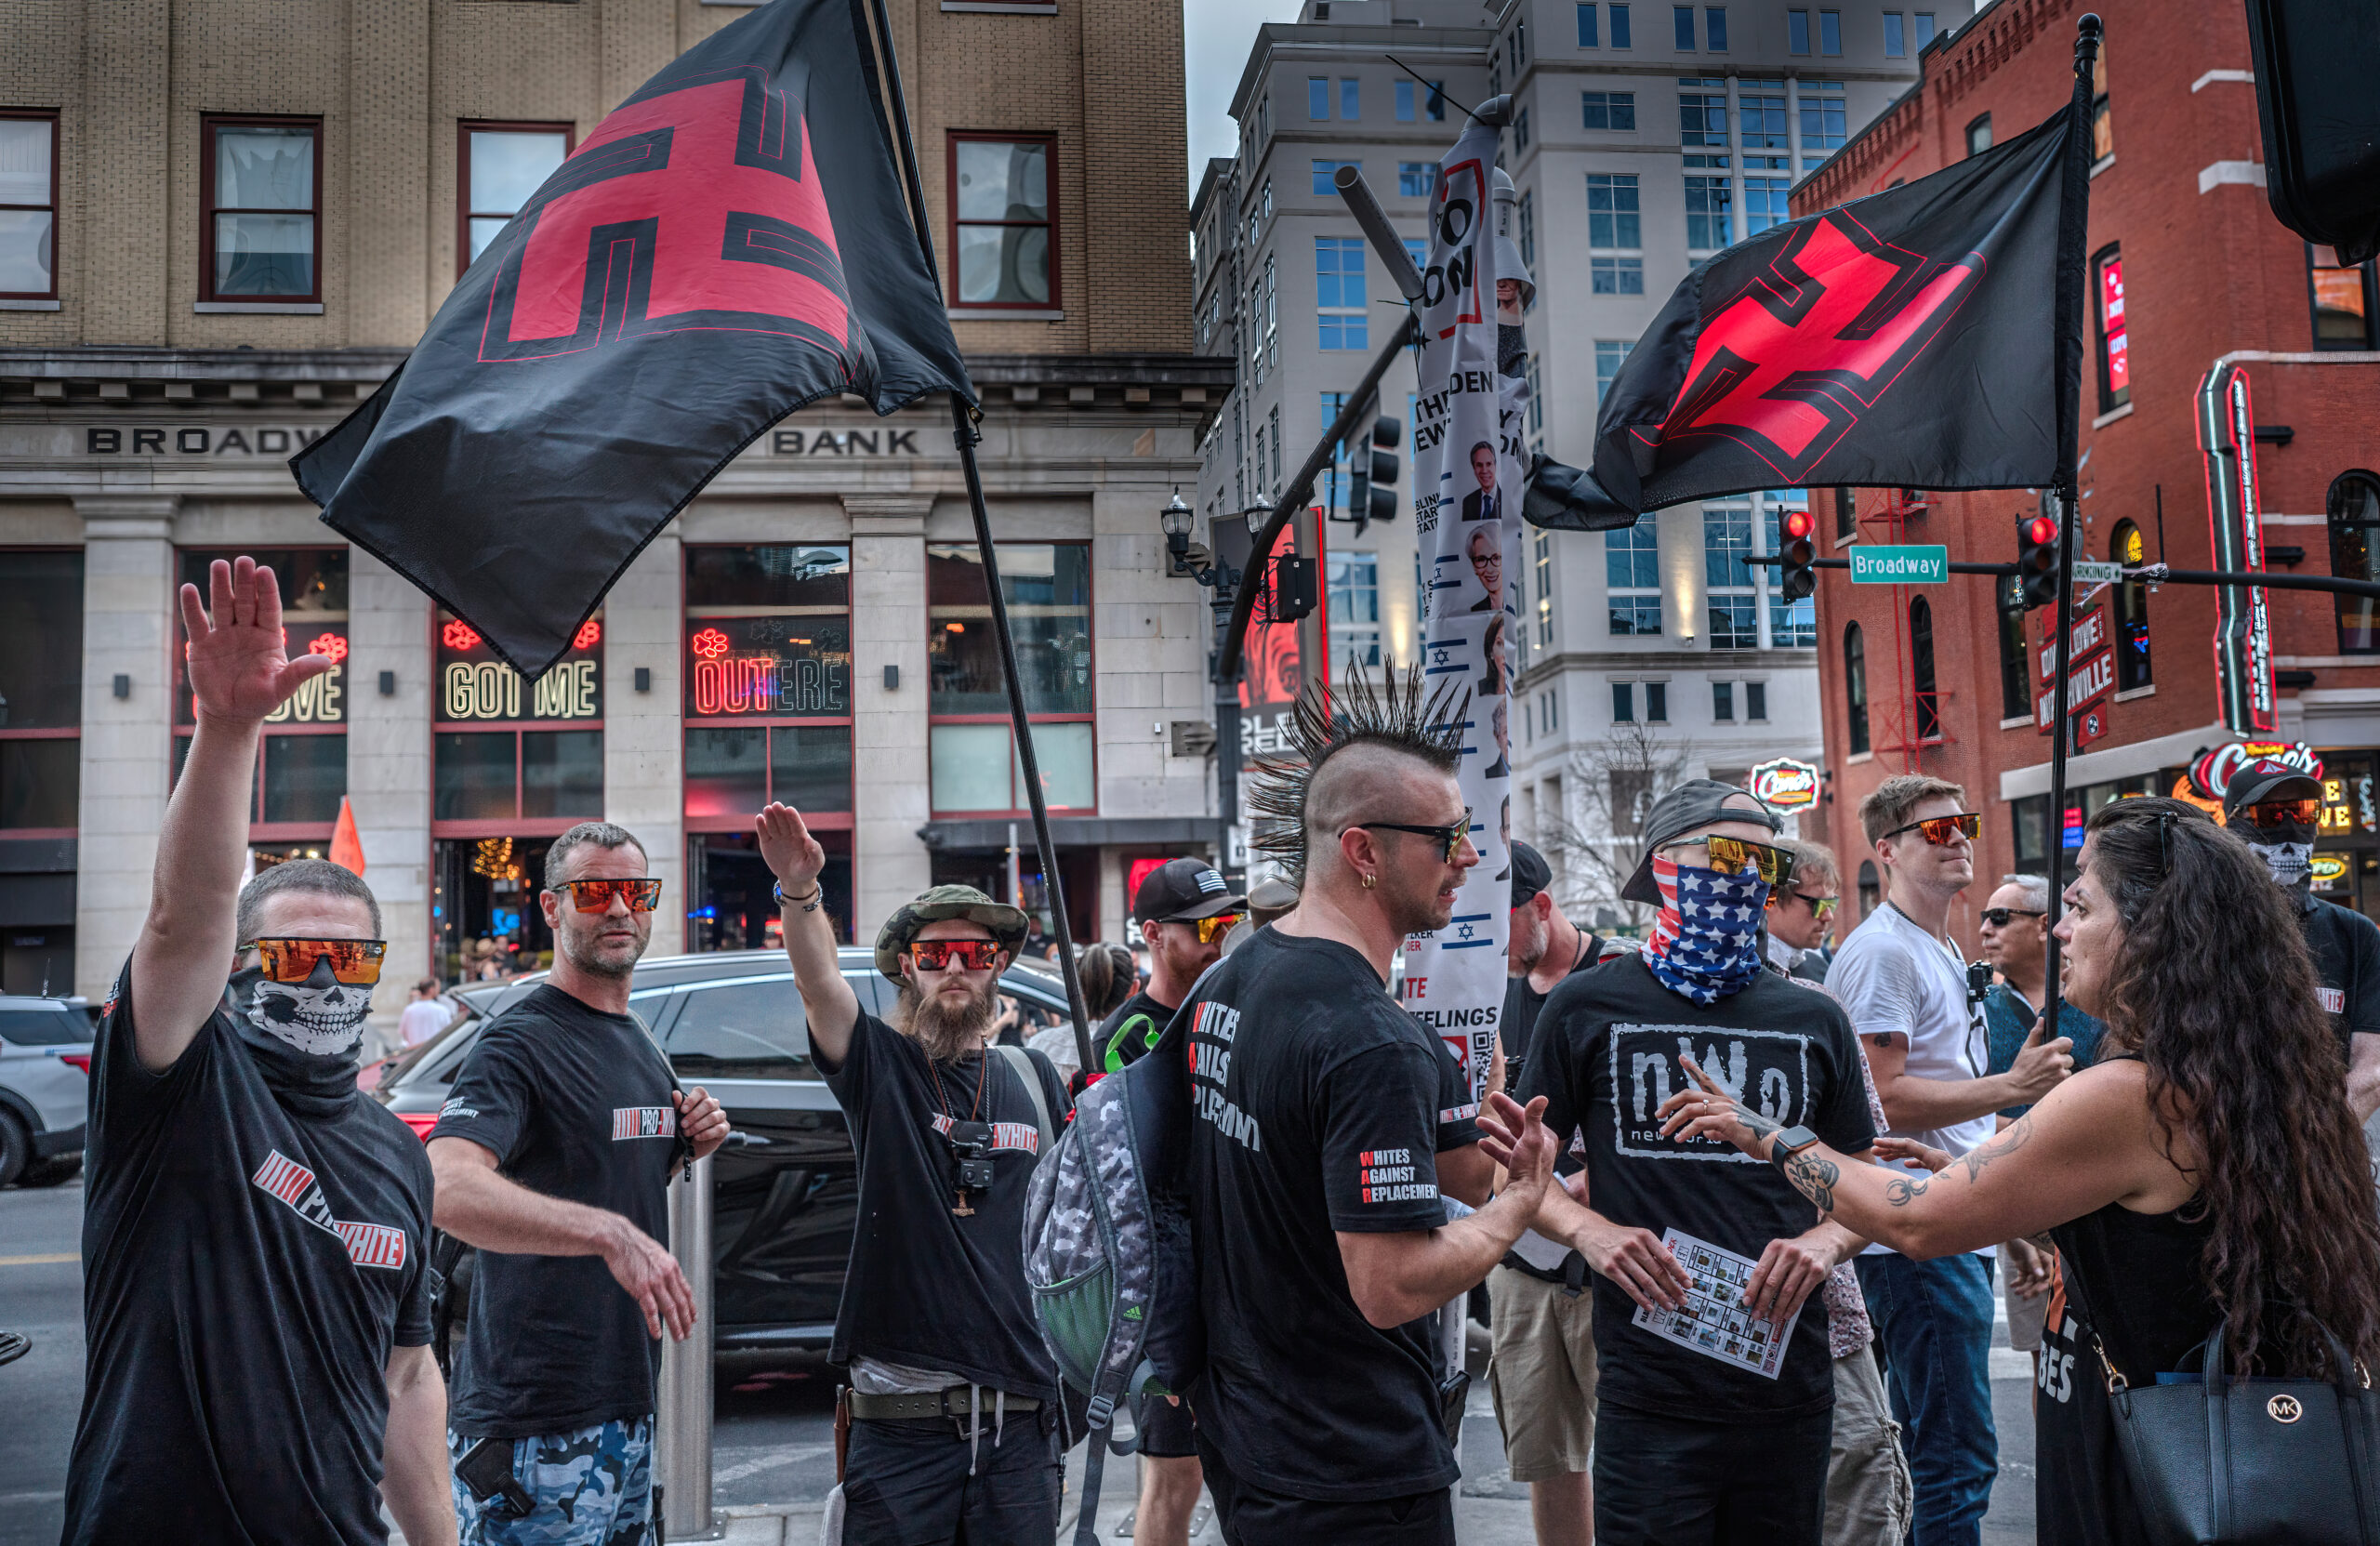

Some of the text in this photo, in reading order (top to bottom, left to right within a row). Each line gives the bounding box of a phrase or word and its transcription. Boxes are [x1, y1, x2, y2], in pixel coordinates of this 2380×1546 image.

[1449, 370, 1493, 395] DEN
[774, 429, 919, 456] BANK
[1856, 555, 1941, 578] Broadway
[445, 660, 597, 719] GOT ME
[694, 657, 774, 714] OUT
[1404, 977, 1428, 998] TE
[1409, 1006, 1497, 1028] ELINGS
[641, 1109, 675, 1135] PRO-WH
[1360, 1148, 1410, 1168] WHITES
[1361, 1167, 1415, 1185] AGAINST
[2269, 1401, 2297, 1415] MK
